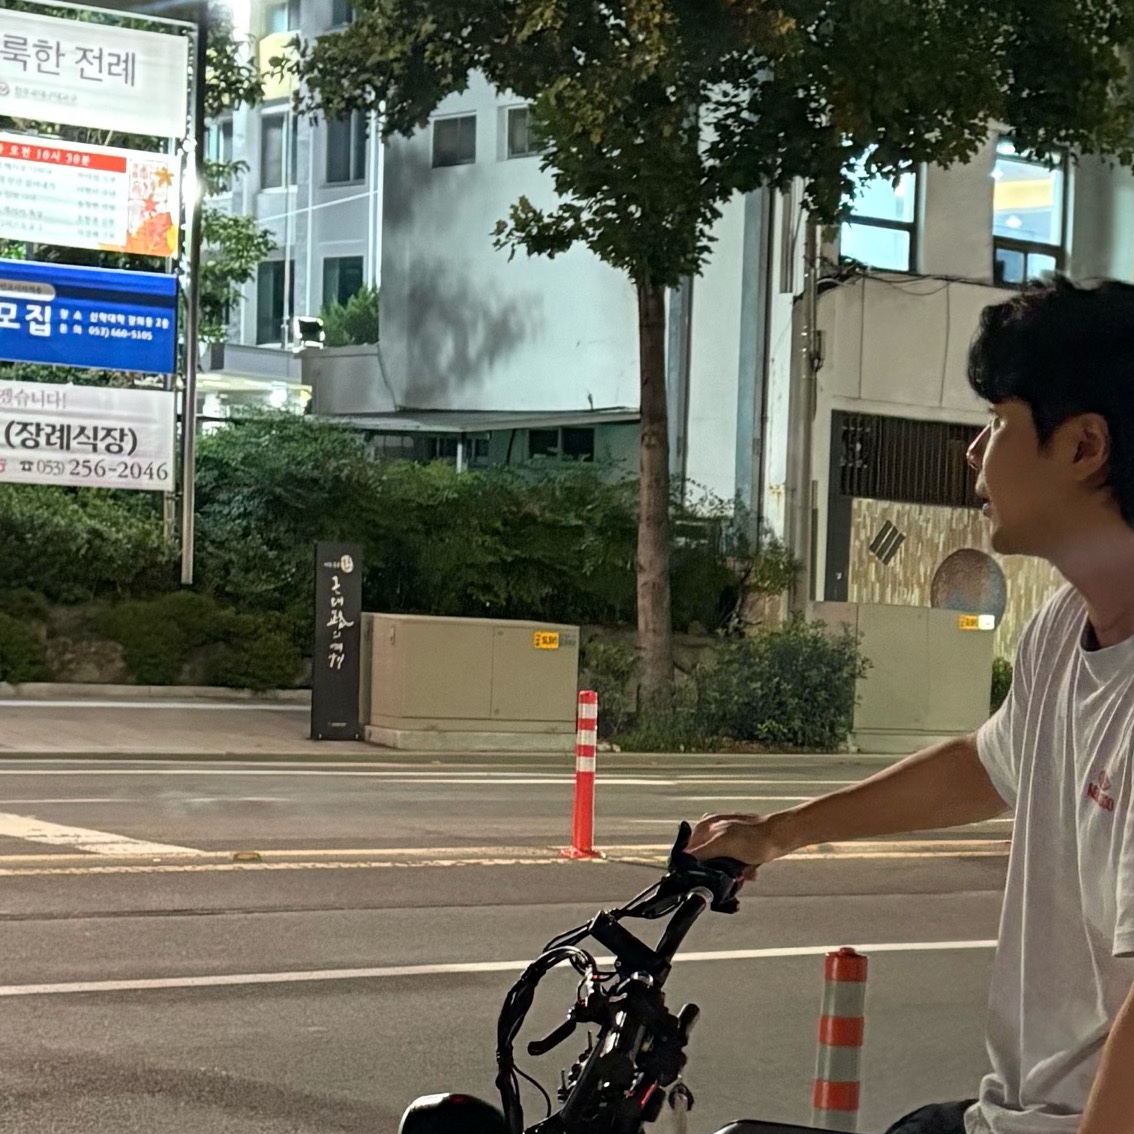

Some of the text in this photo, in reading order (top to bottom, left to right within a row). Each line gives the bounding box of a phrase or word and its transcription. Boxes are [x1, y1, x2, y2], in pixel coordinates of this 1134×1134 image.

[74, 46, 136, 87] 전례
[0, 302, 51, 337] 모집
[4, 420, 138, 456] (장례식장)
[69, 459, 168, 481] 256-2046
